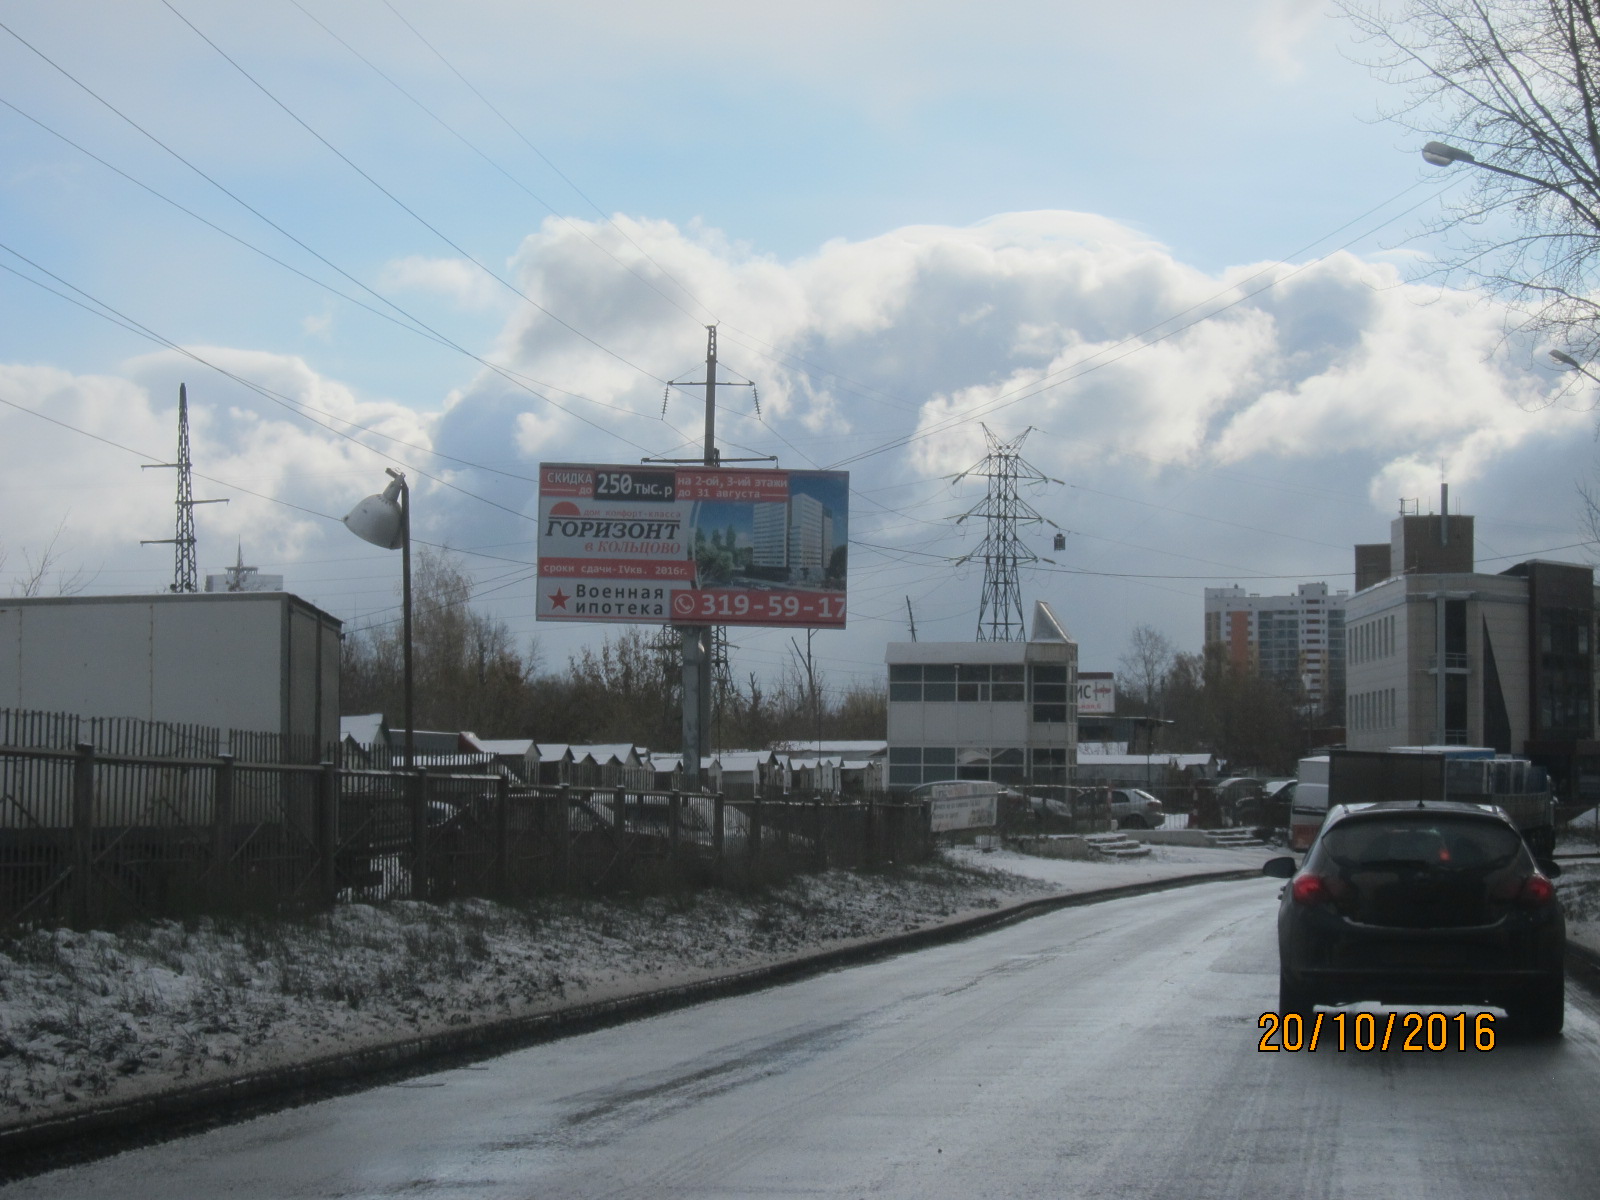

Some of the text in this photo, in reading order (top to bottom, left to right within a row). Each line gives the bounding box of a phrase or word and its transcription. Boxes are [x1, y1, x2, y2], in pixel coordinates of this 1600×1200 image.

[547, 472, 593, 485] СКИДКА
[597, 473, 632, 495] 250
[677, 475, 788, 488] на 2-ой, 3-ий этажи
[578, 487, 593, 496] до
[678, 488, 760, 500] до 31 августа
[545, 520, 681, 540] ГОРИЗОНТ
[585, 541, 681, 555] в КОЛЬЦОВО
[543, 564, 575, 574] сроки
[576, 584, 664, 600] Военная
[576, 601, 664, 615] ипотека
[701, 594, 846, 618] 319-59-17
